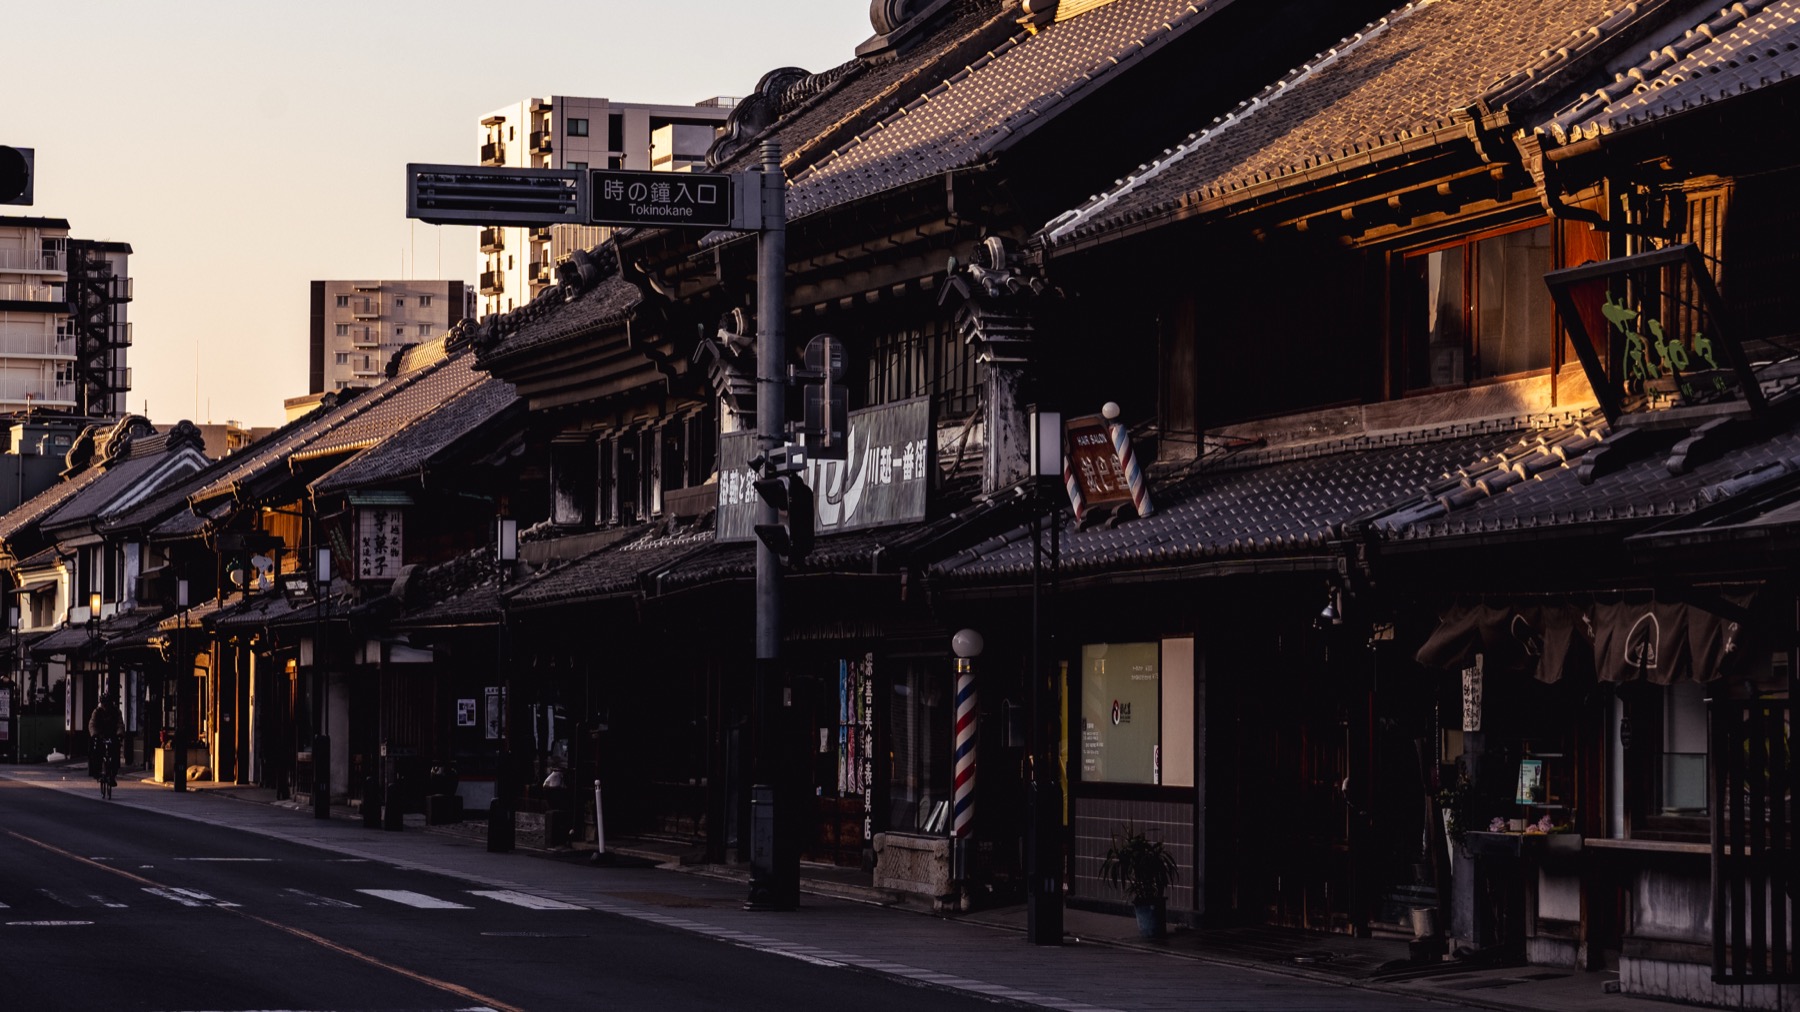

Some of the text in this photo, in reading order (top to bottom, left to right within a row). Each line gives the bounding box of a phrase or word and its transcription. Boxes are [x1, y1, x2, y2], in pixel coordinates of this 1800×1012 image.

[604, 179, 717, 205] 時の鐘入口
[628, 203, 694, 216] Tokinokane
[1077, 433, 1108, 446] HAIR SALON
[867, 439, 927, 485] 川越一番街
